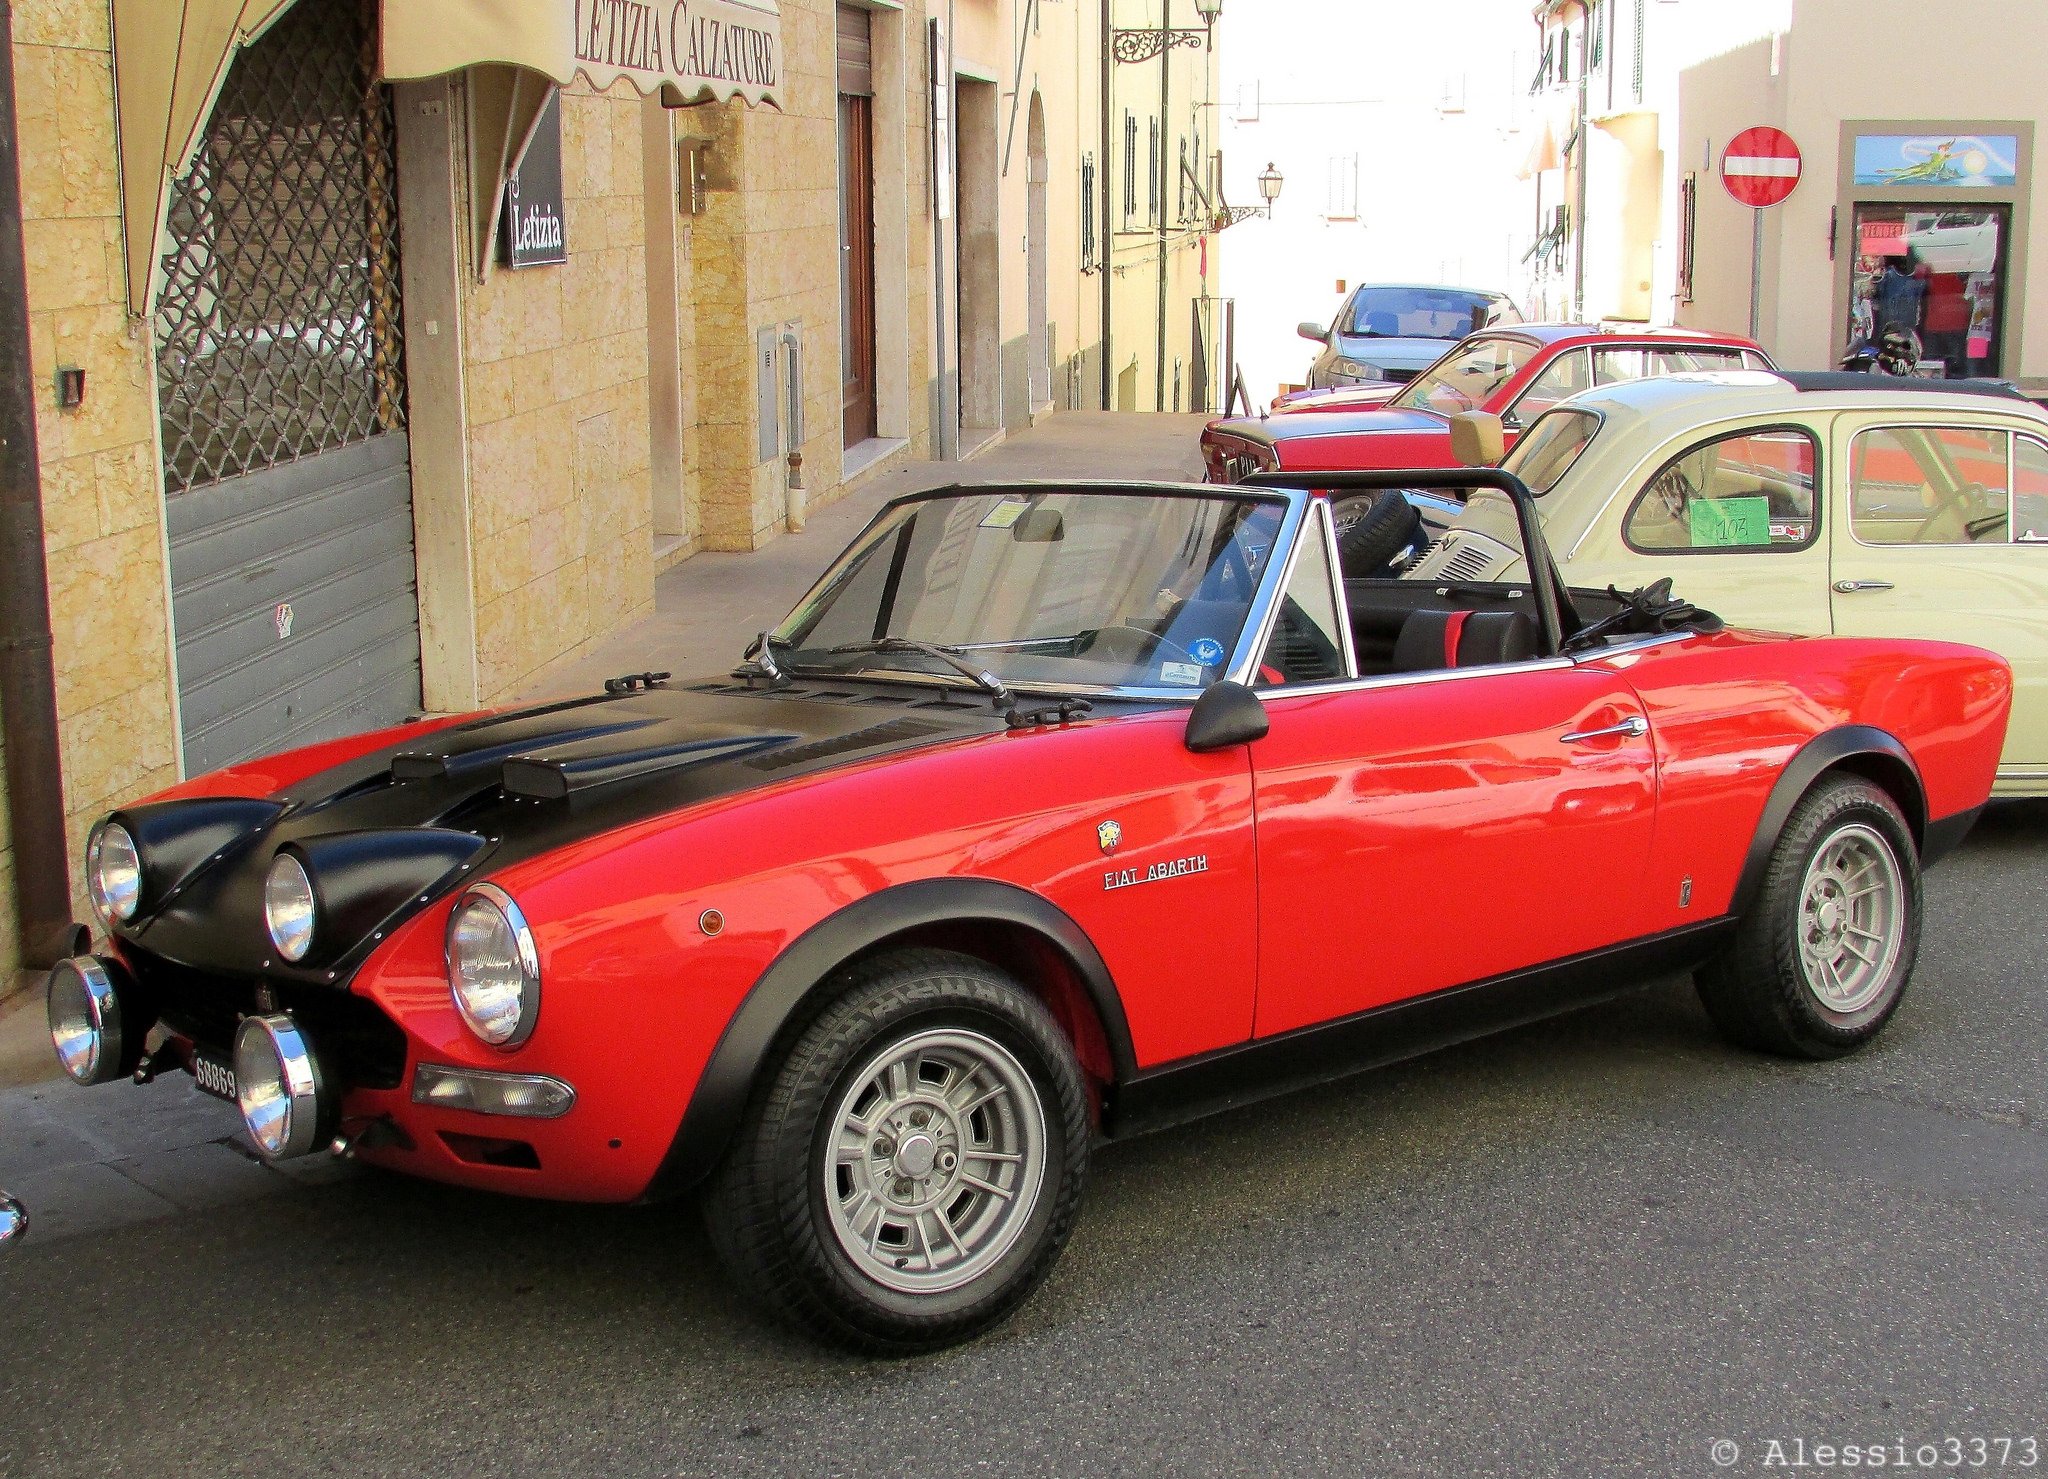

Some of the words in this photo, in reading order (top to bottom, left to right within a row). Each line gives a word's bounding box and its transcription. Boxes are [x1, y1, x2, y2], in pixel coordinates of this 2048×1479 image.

[574, 0, 665, 73] LETIZIA
[670, 0, 776, 87] CALZATURE
[513, 204, 562, 251] Letizia
[1104, 867, 1138, 889] FIAT
[1147, 854, 1208, 880] ABARTH
[196, 1057, 236, 1099] 68869
